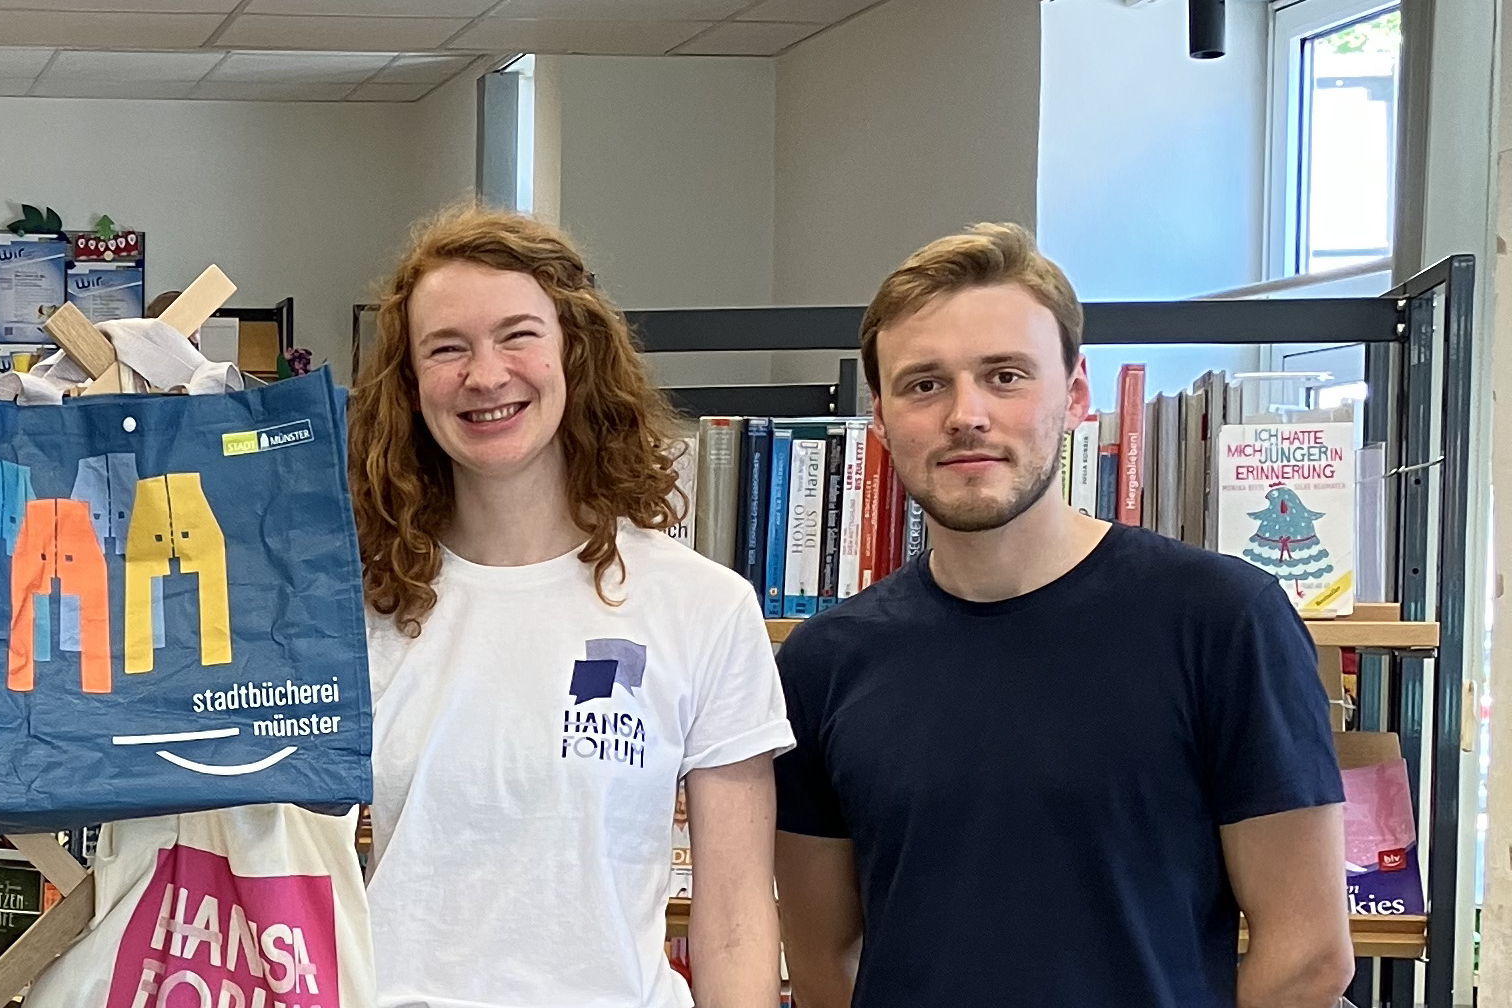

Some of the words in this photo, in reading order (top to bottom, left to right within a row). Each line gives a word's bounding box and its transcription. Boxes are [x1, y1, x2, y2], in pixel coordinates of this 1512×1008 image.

[228, 441, 256, 453] STADT
[270, 429, 310, 446] MÜNSTER
[1255, 428, 1278, 442] ICH
[1281, 430, 1324, 445] HATTE
[855, 441, 864, 476] ZULETZT
[1226, 444, 1263, 458] MICH
[1259, 443, 1329, 464] JÜNGER
[1330, 447, 1343, 462] IN
[805, 452, 820, 498] Harari
[845, 463, 854, 491] LEBEN
[855, 477, 863, 491] BIS
[1125, 432, 1139, 510] Hiergeblieben!
[1235, 464, 1336, 480] ERINNERUNG
[791, 505, 804, 554] HOMO
[805, 510, 817, 548] DEUS
[908, 518, 922, 556] SECRET
[192, 676, 340, 712] stadtbücherei
[253, 714, 341, 737] münster
[564, 710, 645, 742] HANSA
[561, 736, 644, 768] FORUM
[1383, 855, 1400, 863] blv
[150, 883, 319, 995] HANSA
